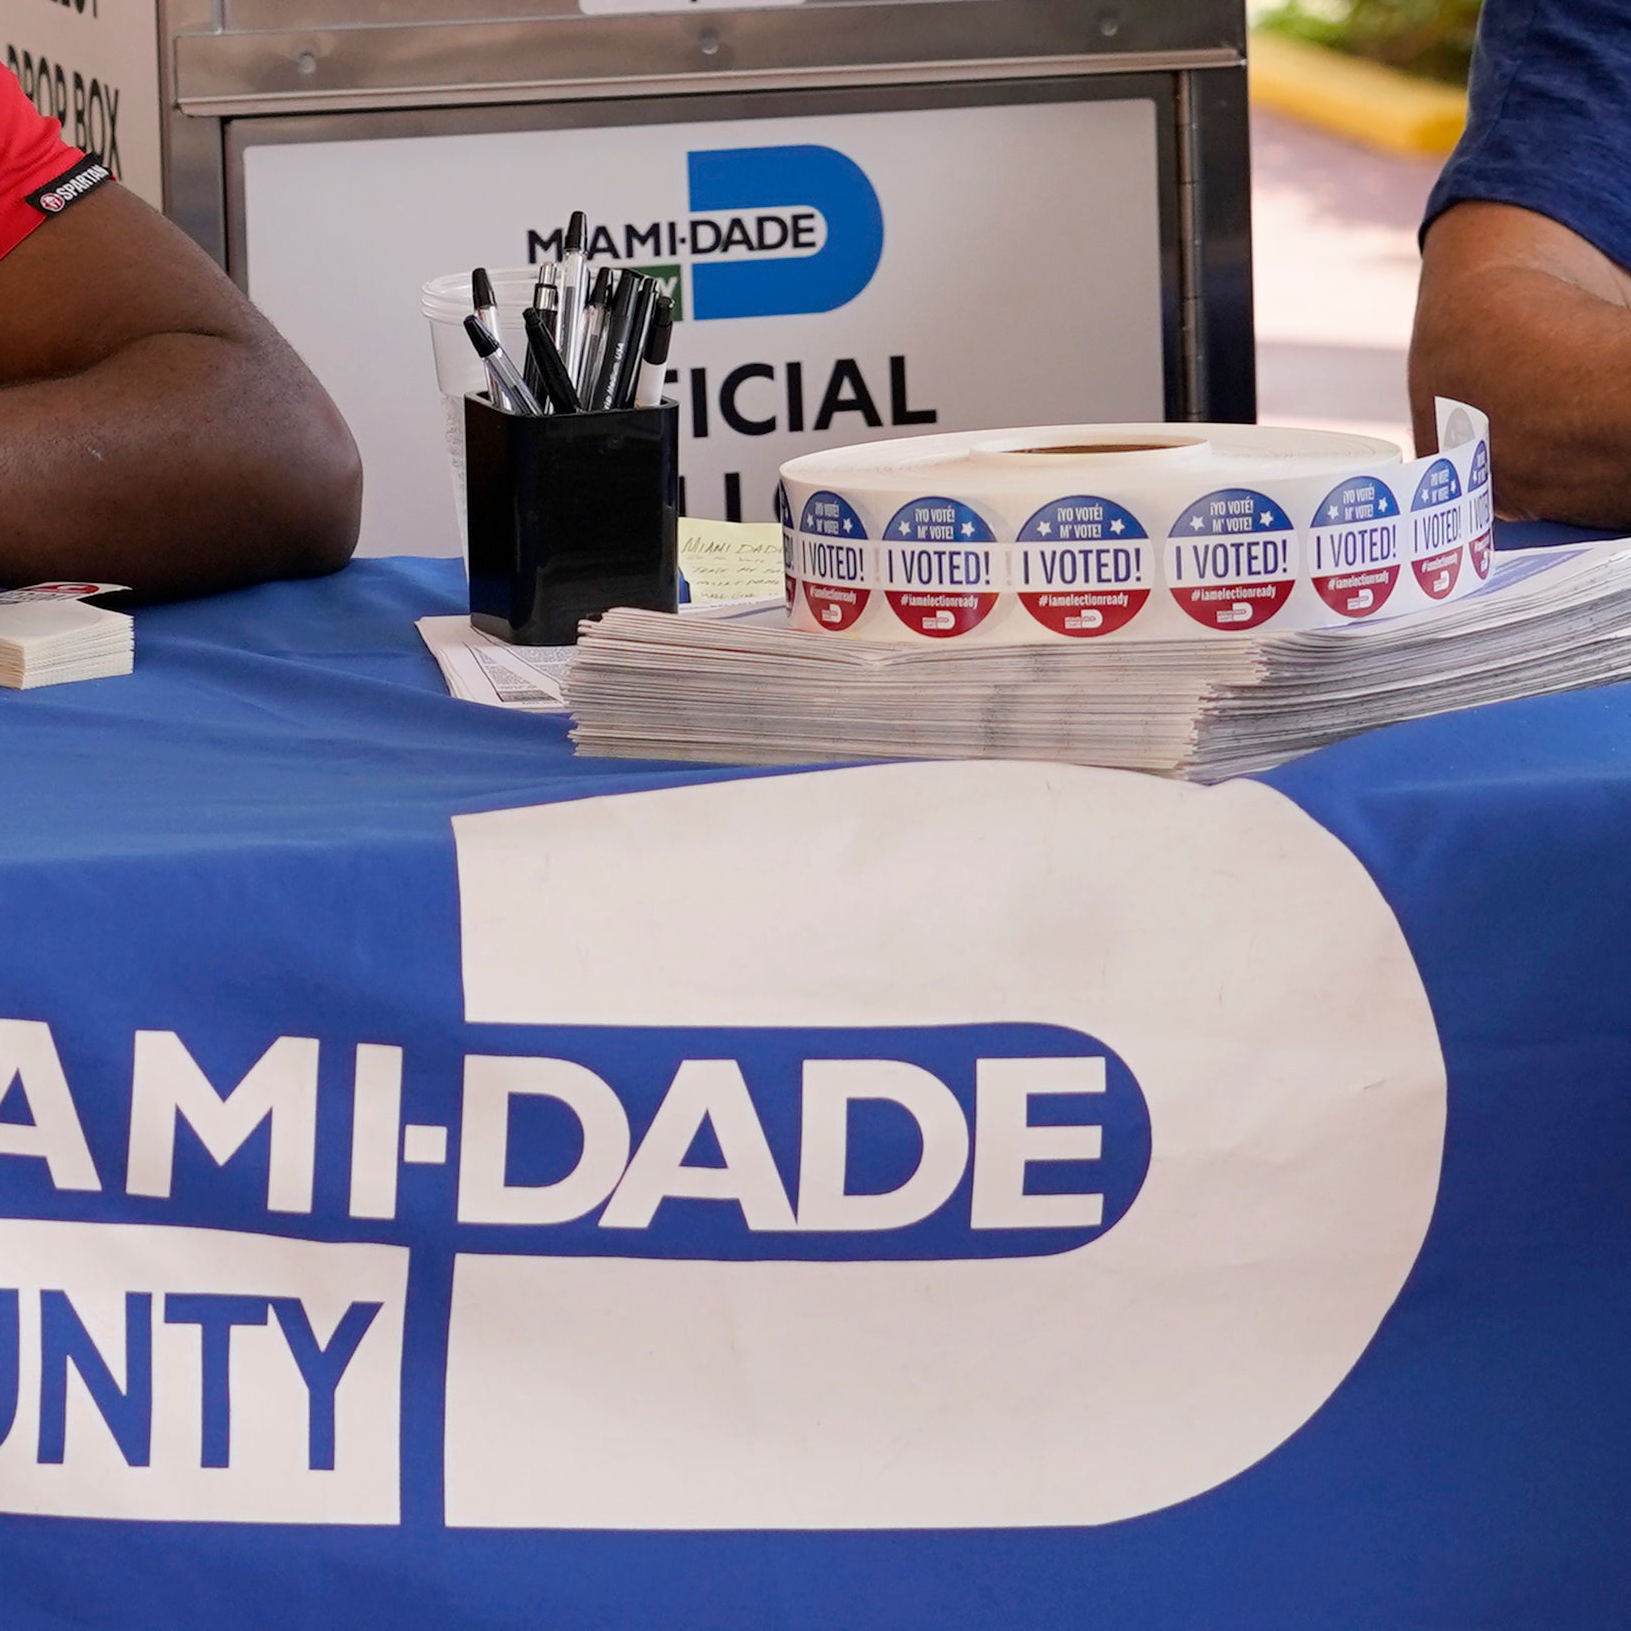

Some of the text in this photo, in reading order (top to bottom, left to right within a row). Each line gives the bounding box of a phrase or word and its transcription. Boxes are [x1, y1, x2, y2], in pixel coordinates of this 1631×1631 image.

[73, 71, 123, 181] BOX
[55, 163, 110, 201] SPARTAN
[526, 212, 818, 265] MAMI-DADE
[664, 354, 938, 439] ICIAL
[1075, 503, 1103, 521] VOTÉ!
[1227, 495, 1254, 514] VOTÉ!
[1074, 524, 1103, 538] VOTE!
[1226, 517, 1253, 532] VOTE!
[1414, 504, 1461, 553] I VOTED!
[736, 544, 783, 554] DAD
[802, 540, 807, 574] I
[808, 541, 865, 582] VOTED!
[1175, 539, 1288, 580] I VOTED!
[1316, 535, 1321, 569] I
[1330, 524, 1396, 568] VOTED!
[888, 549, 990, 585] I VOTED!
[1023, 547, 1142, 585] I VOTED!
[1038, 592, 1129, 608] #iamelectionready
[1191, 583, 1277, 601] #iamelectionready
